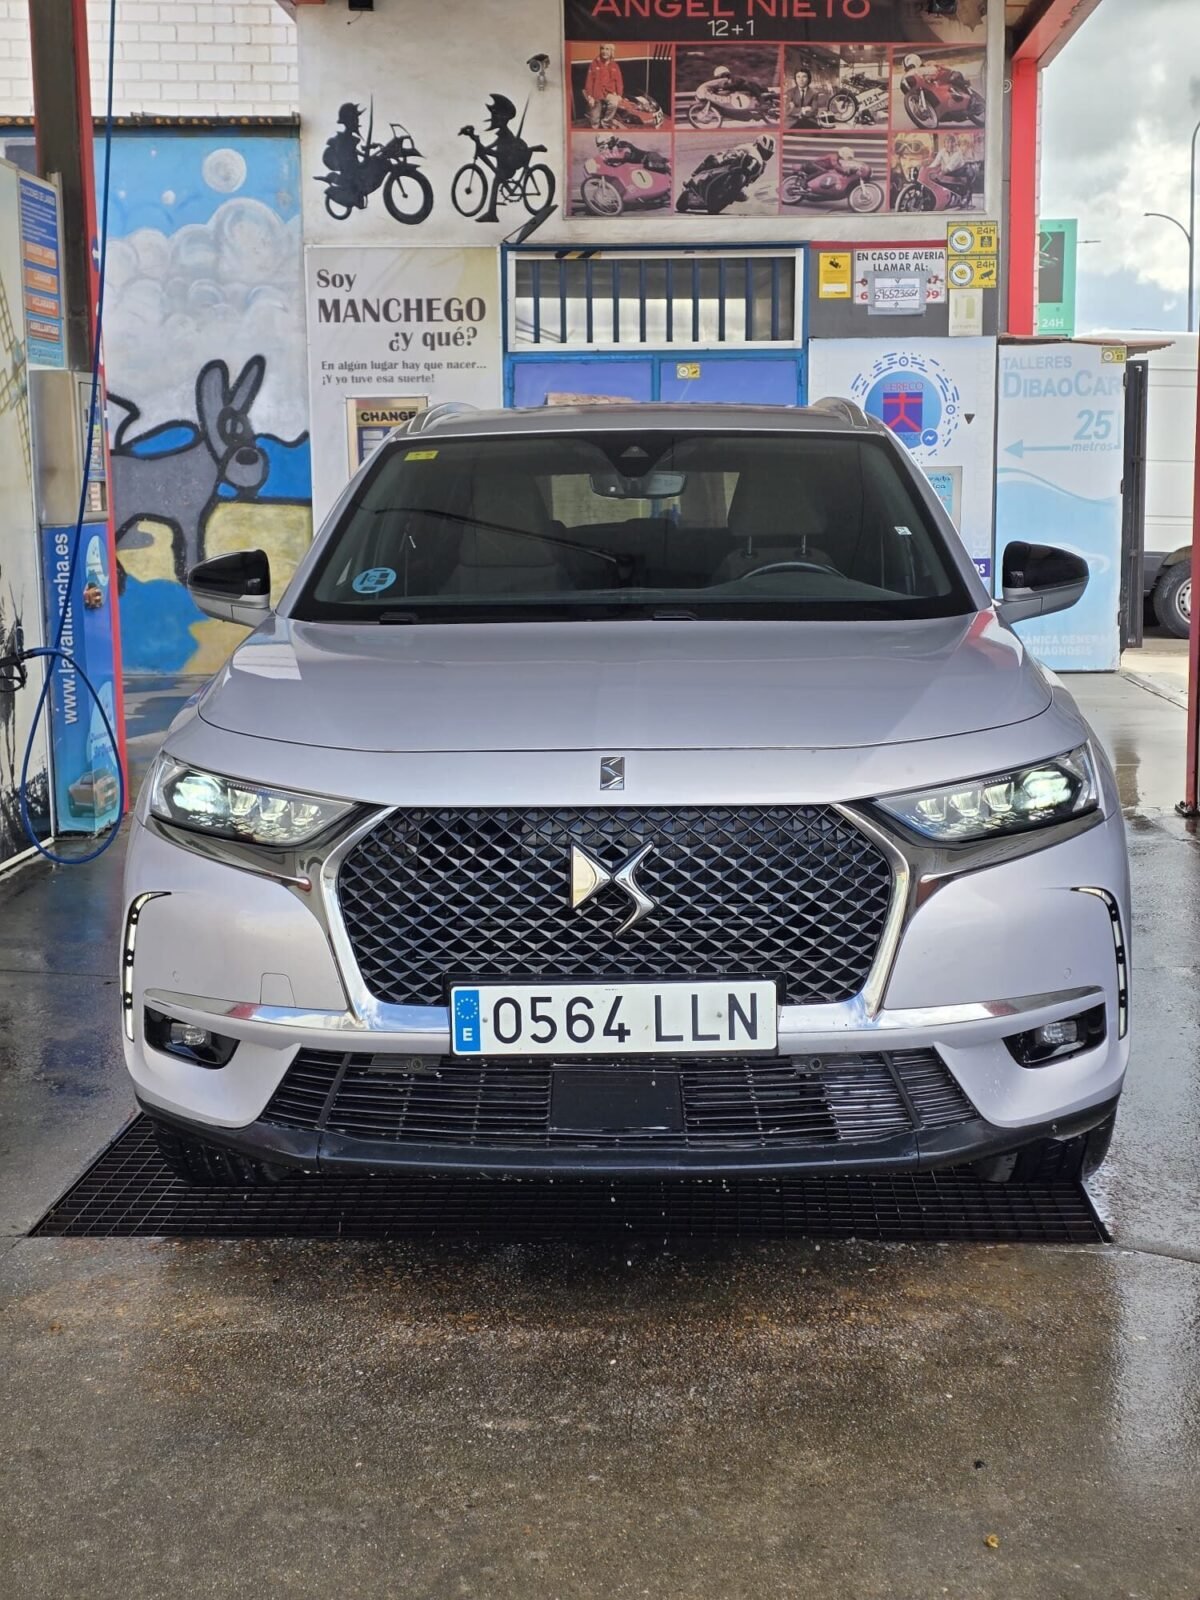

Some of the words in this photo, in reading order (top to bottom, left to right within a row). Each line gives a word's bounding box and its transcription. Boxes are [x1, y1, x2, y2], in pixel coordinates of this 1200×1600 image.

[747, 0, 870, 18] NIETO
[708, 20, 754, 36] 12+1
[977, 227, 995, 235] 24H
[857, 252, 868, 261] EN
[871, 252, 897, 261] CASO
[900, 252, 909, 260] DE
[912, 250, 944, 260] AVERIA
[873, 263, 911, 272] LLAMAR
[914, 263, 928, 272] AL:
[977, 261, 995, 269] 24H
[317, 269, 356, 292] Soy
[318, 297, 486, 323] MANCHEGO
[1042, 319, 1064, 328] 24H
[389, 331, 413, 351] ¿y
[422, 326, 477, 351] qué?
[321, 361, 334, 370] En
[338, 360, 367, 372] algún
[371, 360, 398, 371] lugar
[402, 360, 420, 371] hay
[424, 362, 443, 371] que
[446, 361, 487, 369] nacer...
[1003, 356, 1072, 369] TALLERES
[336, 376, 347, 384] yo
[351, 375, 372, 383] tuve
[376, 375, 394, 383] esa
[398, 374, 435, 383] suerte!
[361, 411, 417, 422] CHANGE
[1074, 409, 1114, 440] 25
[1071, 441, 1113, 452] metros
[493, 995, 632, 1044] 0564
[654, 992, 758, 1043] LLN
[463, 1028, 473, 1041] E
